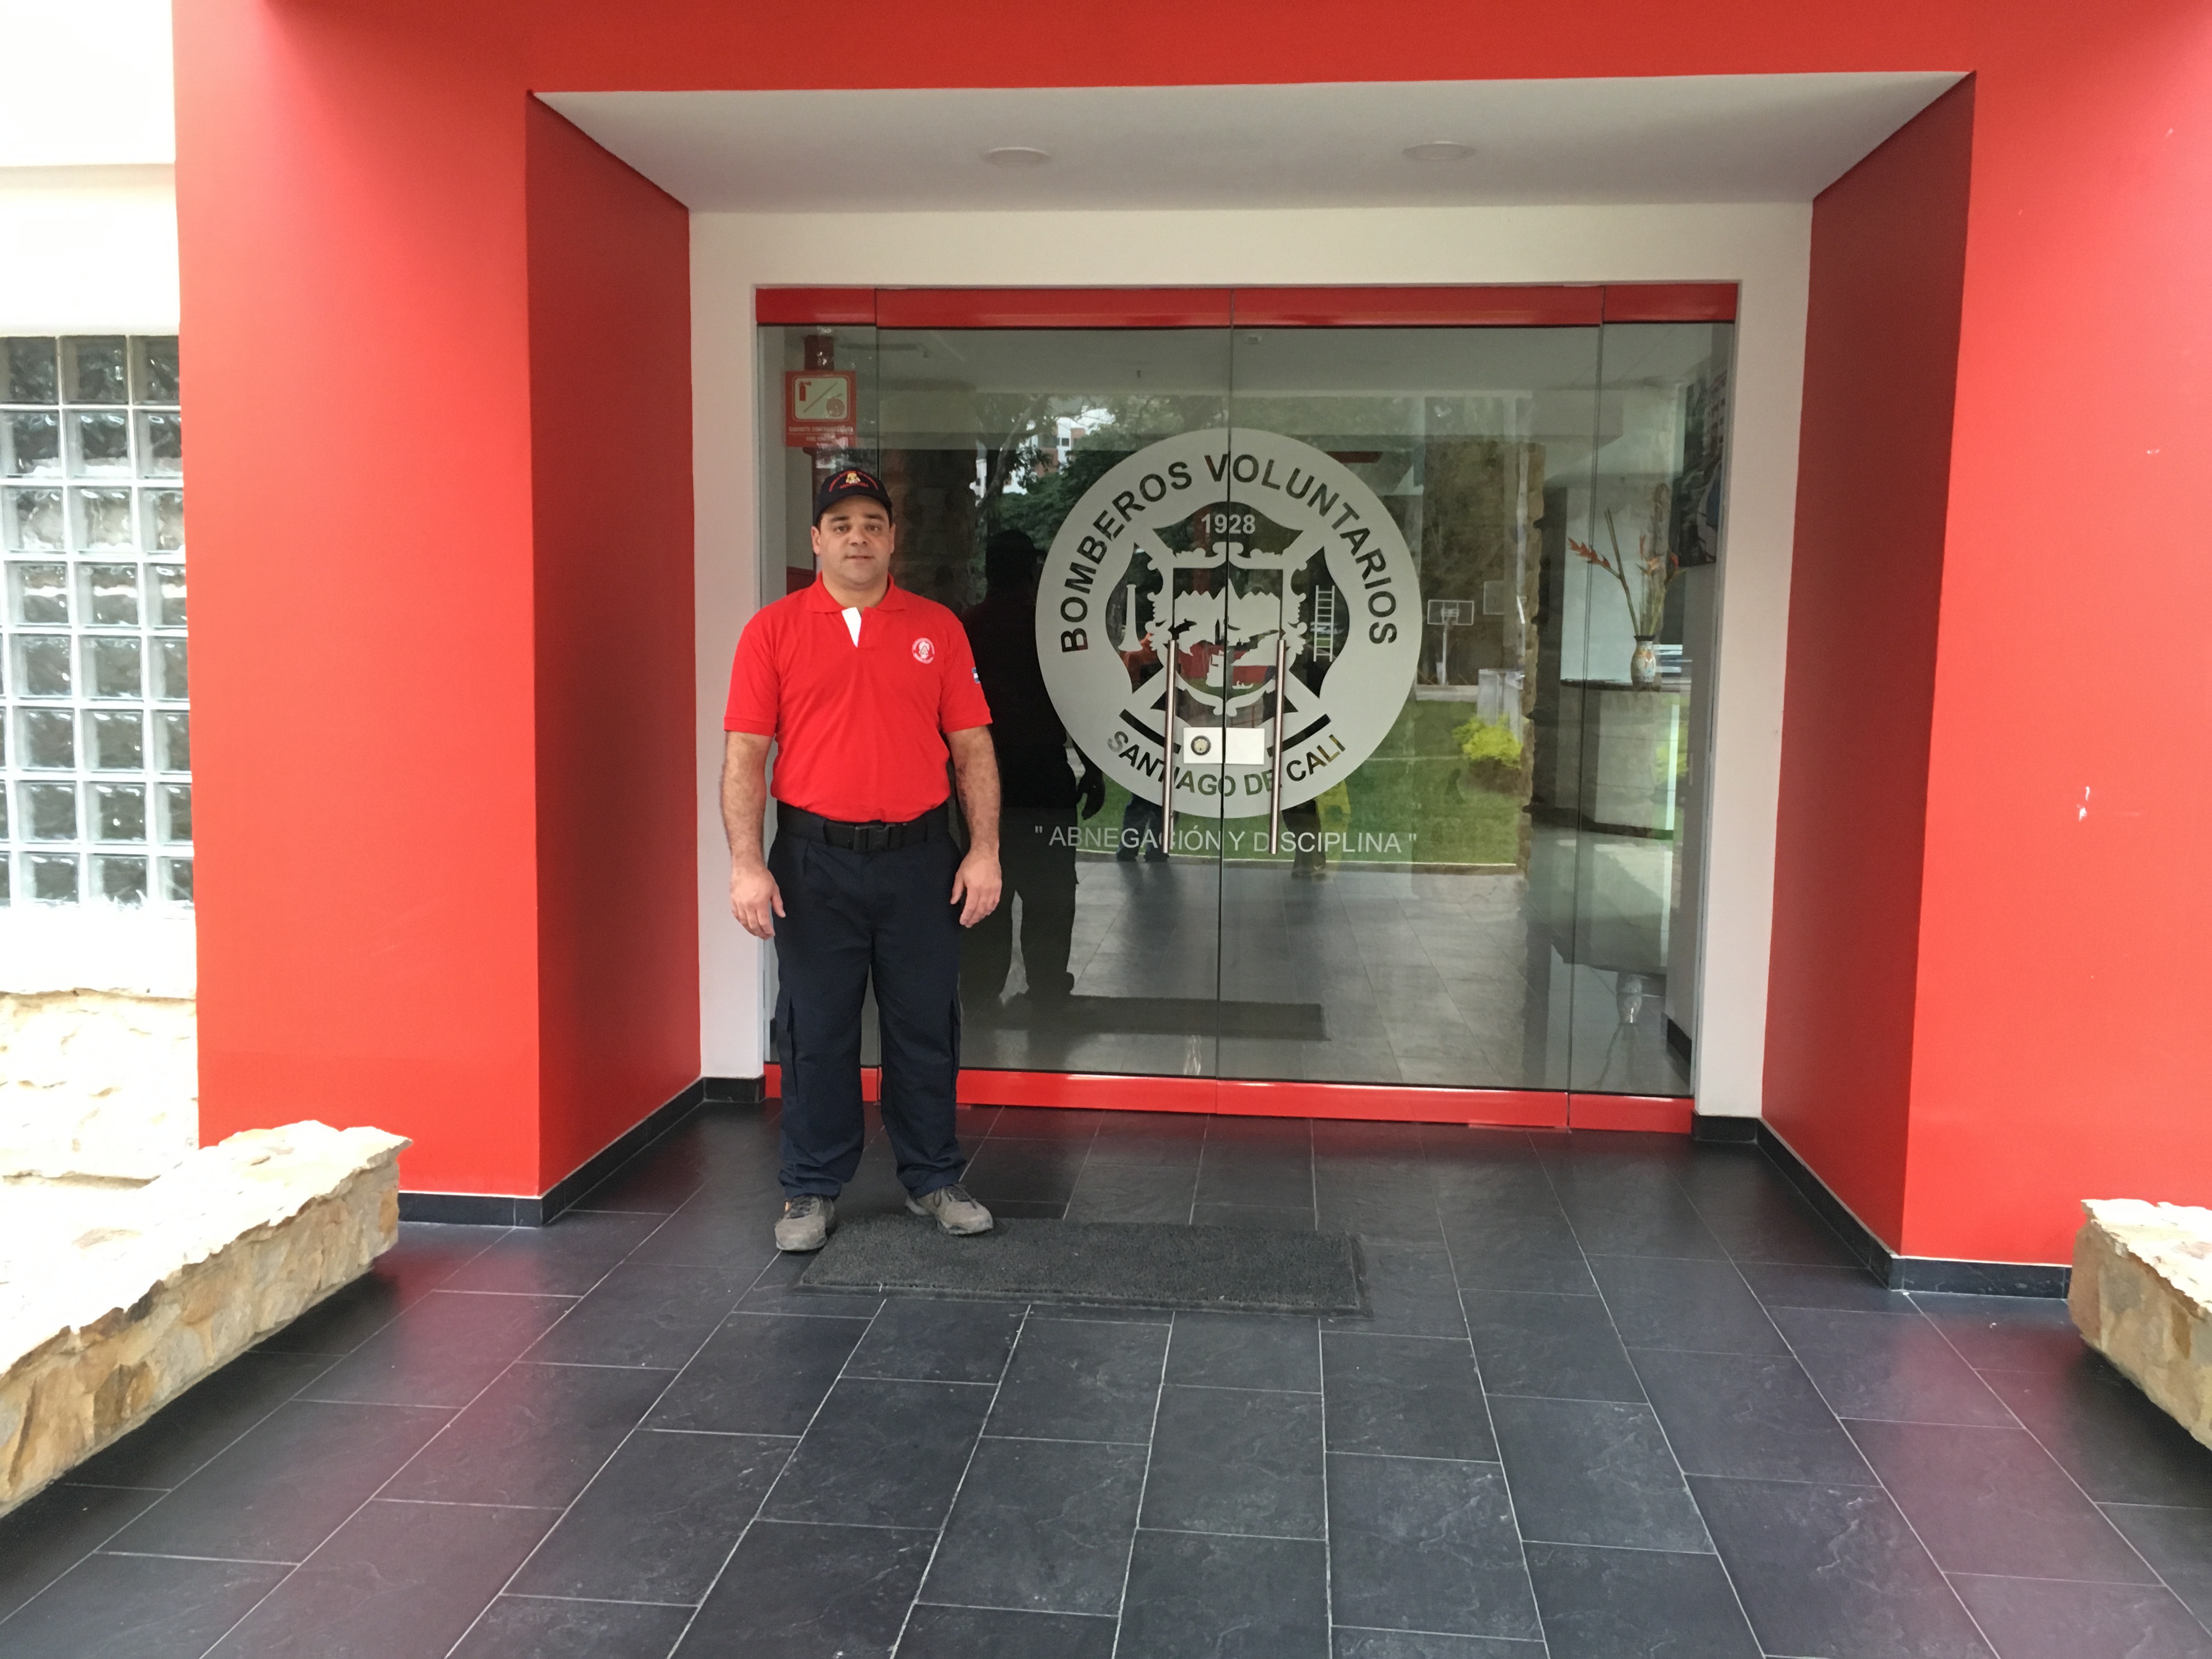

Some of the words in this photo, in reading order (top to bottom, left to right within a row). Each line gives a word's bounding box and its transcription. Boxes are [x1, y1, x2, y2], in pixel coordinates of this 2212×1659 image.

[1201, 513, 1256, 534] 1928
[1060, 461, 1193, 653] BOMBEROS
[1204, 454, 1397, 645] VOLUNTARIOS
[1286, 733, 1346, 782] CALI
[1228, 831, 1246, 851] Y
[1254, 831, 1402, 853] DSCIPLINA
